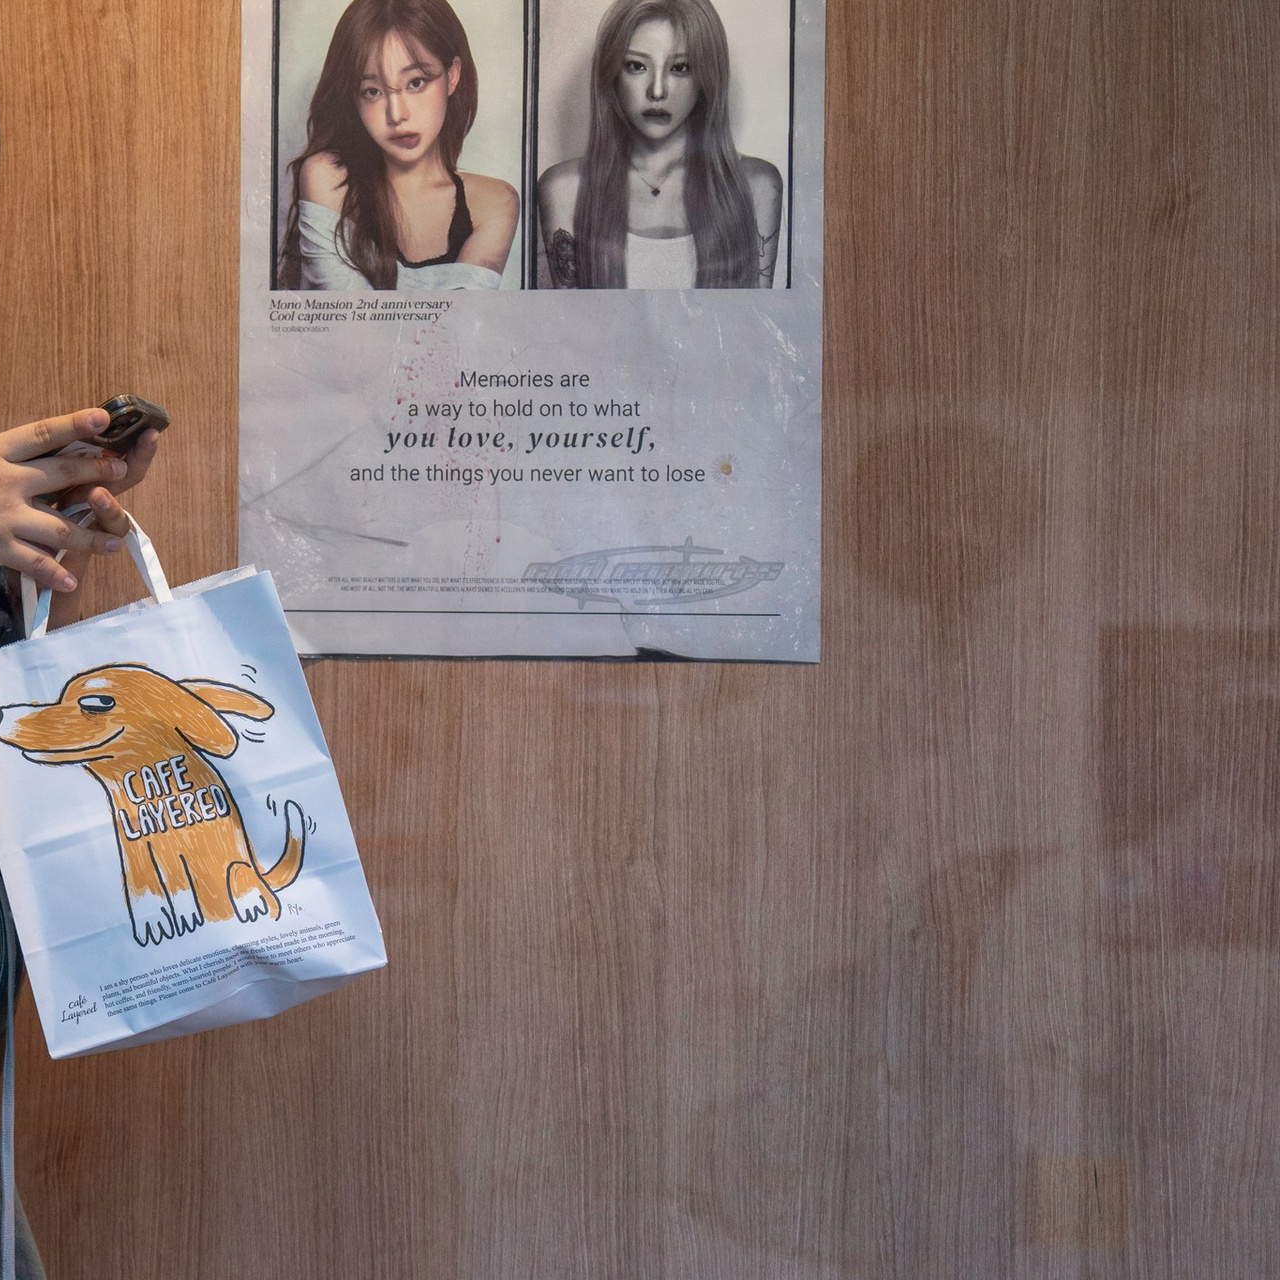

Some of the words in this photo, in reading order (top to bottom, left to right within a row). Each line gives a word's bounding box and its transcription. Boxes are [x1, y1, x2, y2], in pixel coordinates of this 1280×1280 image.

[269, 299, 302, 310] Mono
[304, 299, 353, 310] Mansion
[356, 299, 378, 310] 2nd
[380, 300, 454, 312] anniversary
[269, 310, 295, 321] Cool
[297, 311, 348, 324] captures
[351, 311, 367, 321] 1st
[369, 311, 443, 324] anniversary
[282, 325, 330, 333] collaboration
[459, 370, 555, 389] Memories
[560, 374, 590, 388] are
[408, 404, 419, 418] a
[424, 403, 461, 422] way
[468, 401, 488, 418] to
[493, 399, 533, 418] hold
[540, 403, 564, 418] on
[569, 401, 589, 418] to
[594, 399, 642, 417] what
[383, 429, 436, 455] you
[448, 427, 516, 453] love,
[524, 425, 657, 454] yourself,
[350, 464, 384, 483] and
[389, 464, 420, 483] the
[425, 463, 484, 489] things
[489, 468, 524, 489] you
[530, 468, 582, 483] never
[588, 465, 636, 483] want
[640, 465, 660, 483] to
[666, 463, 706, 483] lose
[122, 754, 193, 804] CAFE
[117, 783, 230, 842] LAYERED
[122, 985, 132, 994] and
[132, 977, 158, 990] beautiful
[182, 966, 198, 975] What
[203, 958, 224, 969] cherish
[224, 952, 239, 962] most
[250, 946, 265, 954] fresh
[266, 942, 283, 951] bread
[284, 938, 300, 947] made
[308, 934, 317, 942] the
[318, 929, 344, 939] morning,
[130, 973, 148, 984] person
[162, 964, 178, 972] loves
[179, 956, 202, 967] delicate
[202, 948, 231, 960] emotions,
[232, 940, 260, 951] charming
[260, 936, 279, 944] styles,
[280, 930, 298, 939] lovely
[299, 924, 323, 934] animals,
[324, 920, 340, 930] green
[104, 1001, 115, 1009] hot
[135, 990, 146, 999] and
[146, 984, 171, 996] friendly,
[278, 949, 293, 957] meet
[294, 945, 312, 954] others
[326, 935, 356, 947] appreciate
[107, 1008, 122, 1017] these
[123, 1003, 138, 1012] same
[158, 991, 178, 1001] Please
[178, 985, 194, 995] come
[217, 966, 240, 981] Layered
[240, 960, 254, 968] with
[286, 956, 304, 965] heart.
[61, 1001, 98, 1025] Layered
